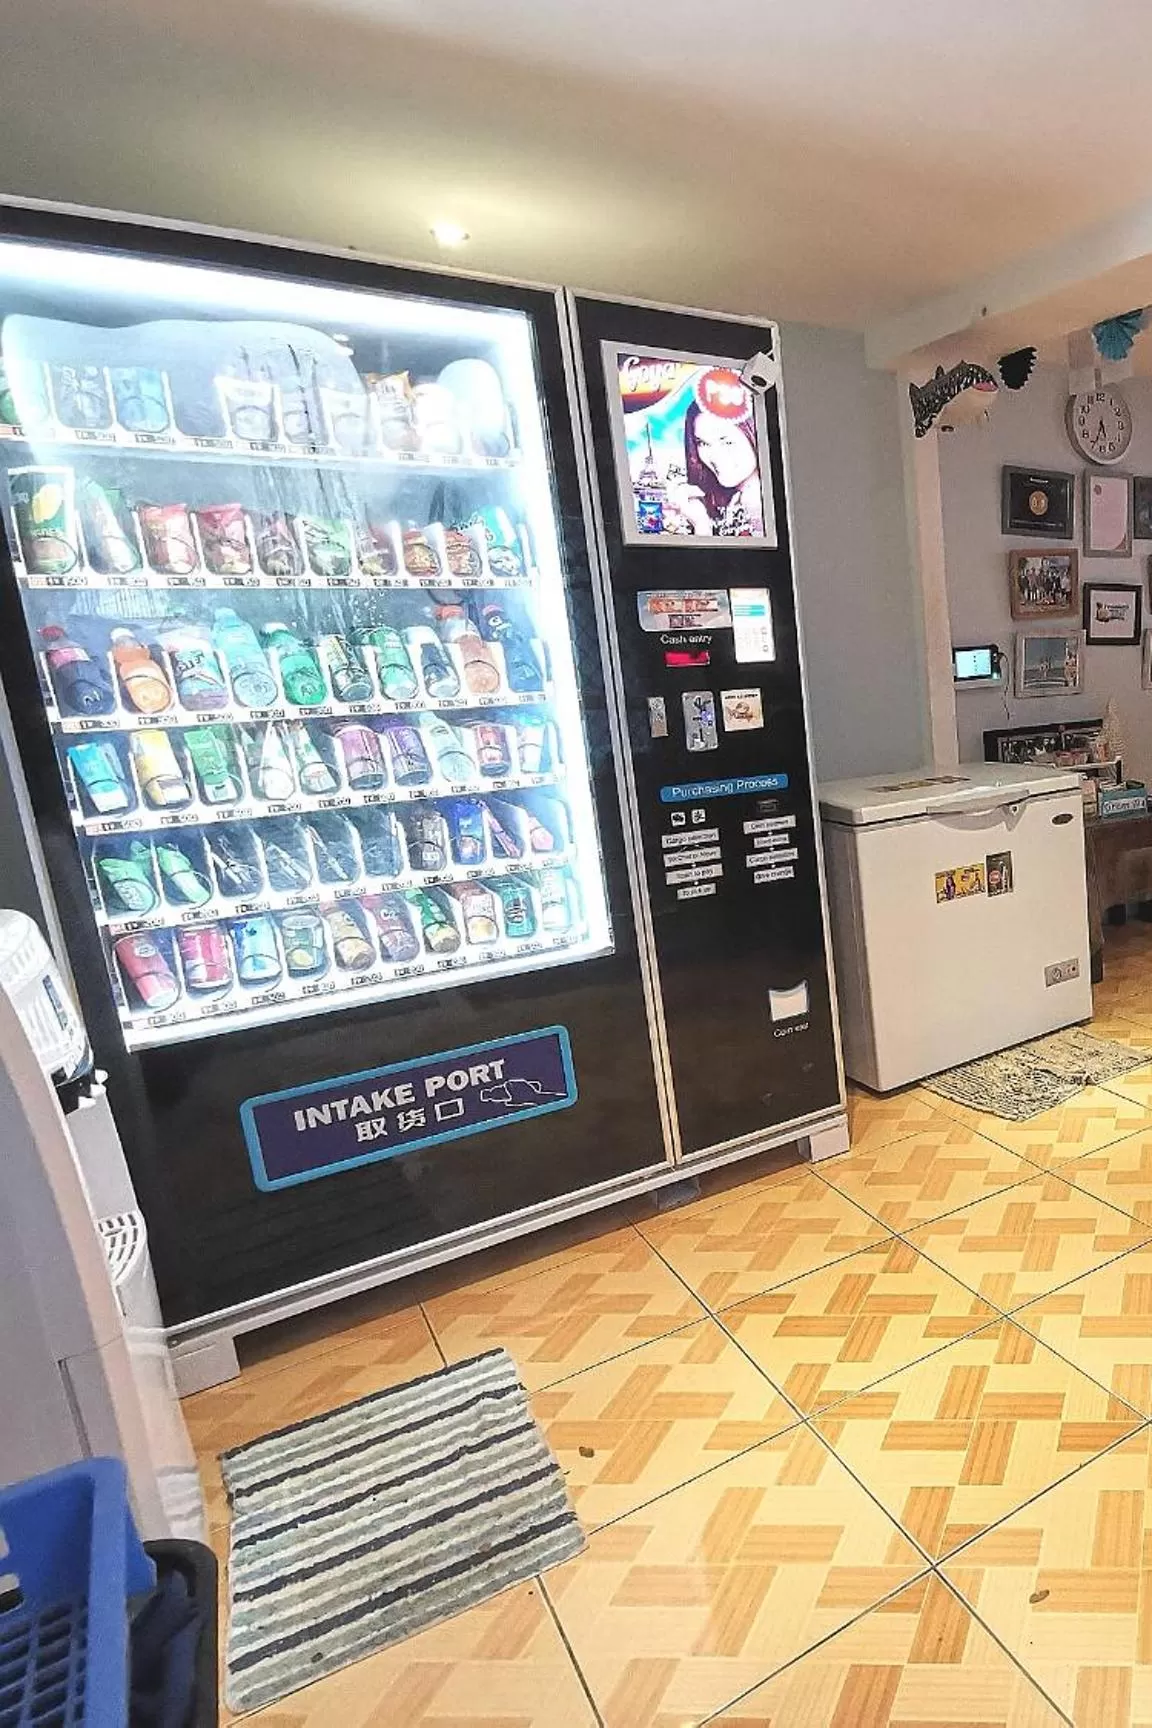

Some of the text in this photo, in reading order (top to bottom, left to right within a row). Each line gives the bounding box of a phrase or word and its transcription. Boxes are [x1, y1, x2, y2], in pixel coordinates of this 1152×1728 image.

[660, 634, 686, 645] Cash
[672, 778, 778, 798] Purchasing Process
[294, 1059, 505, 1132] INTAKE PORT
[355, 1097, 465, 1142] 取货口
